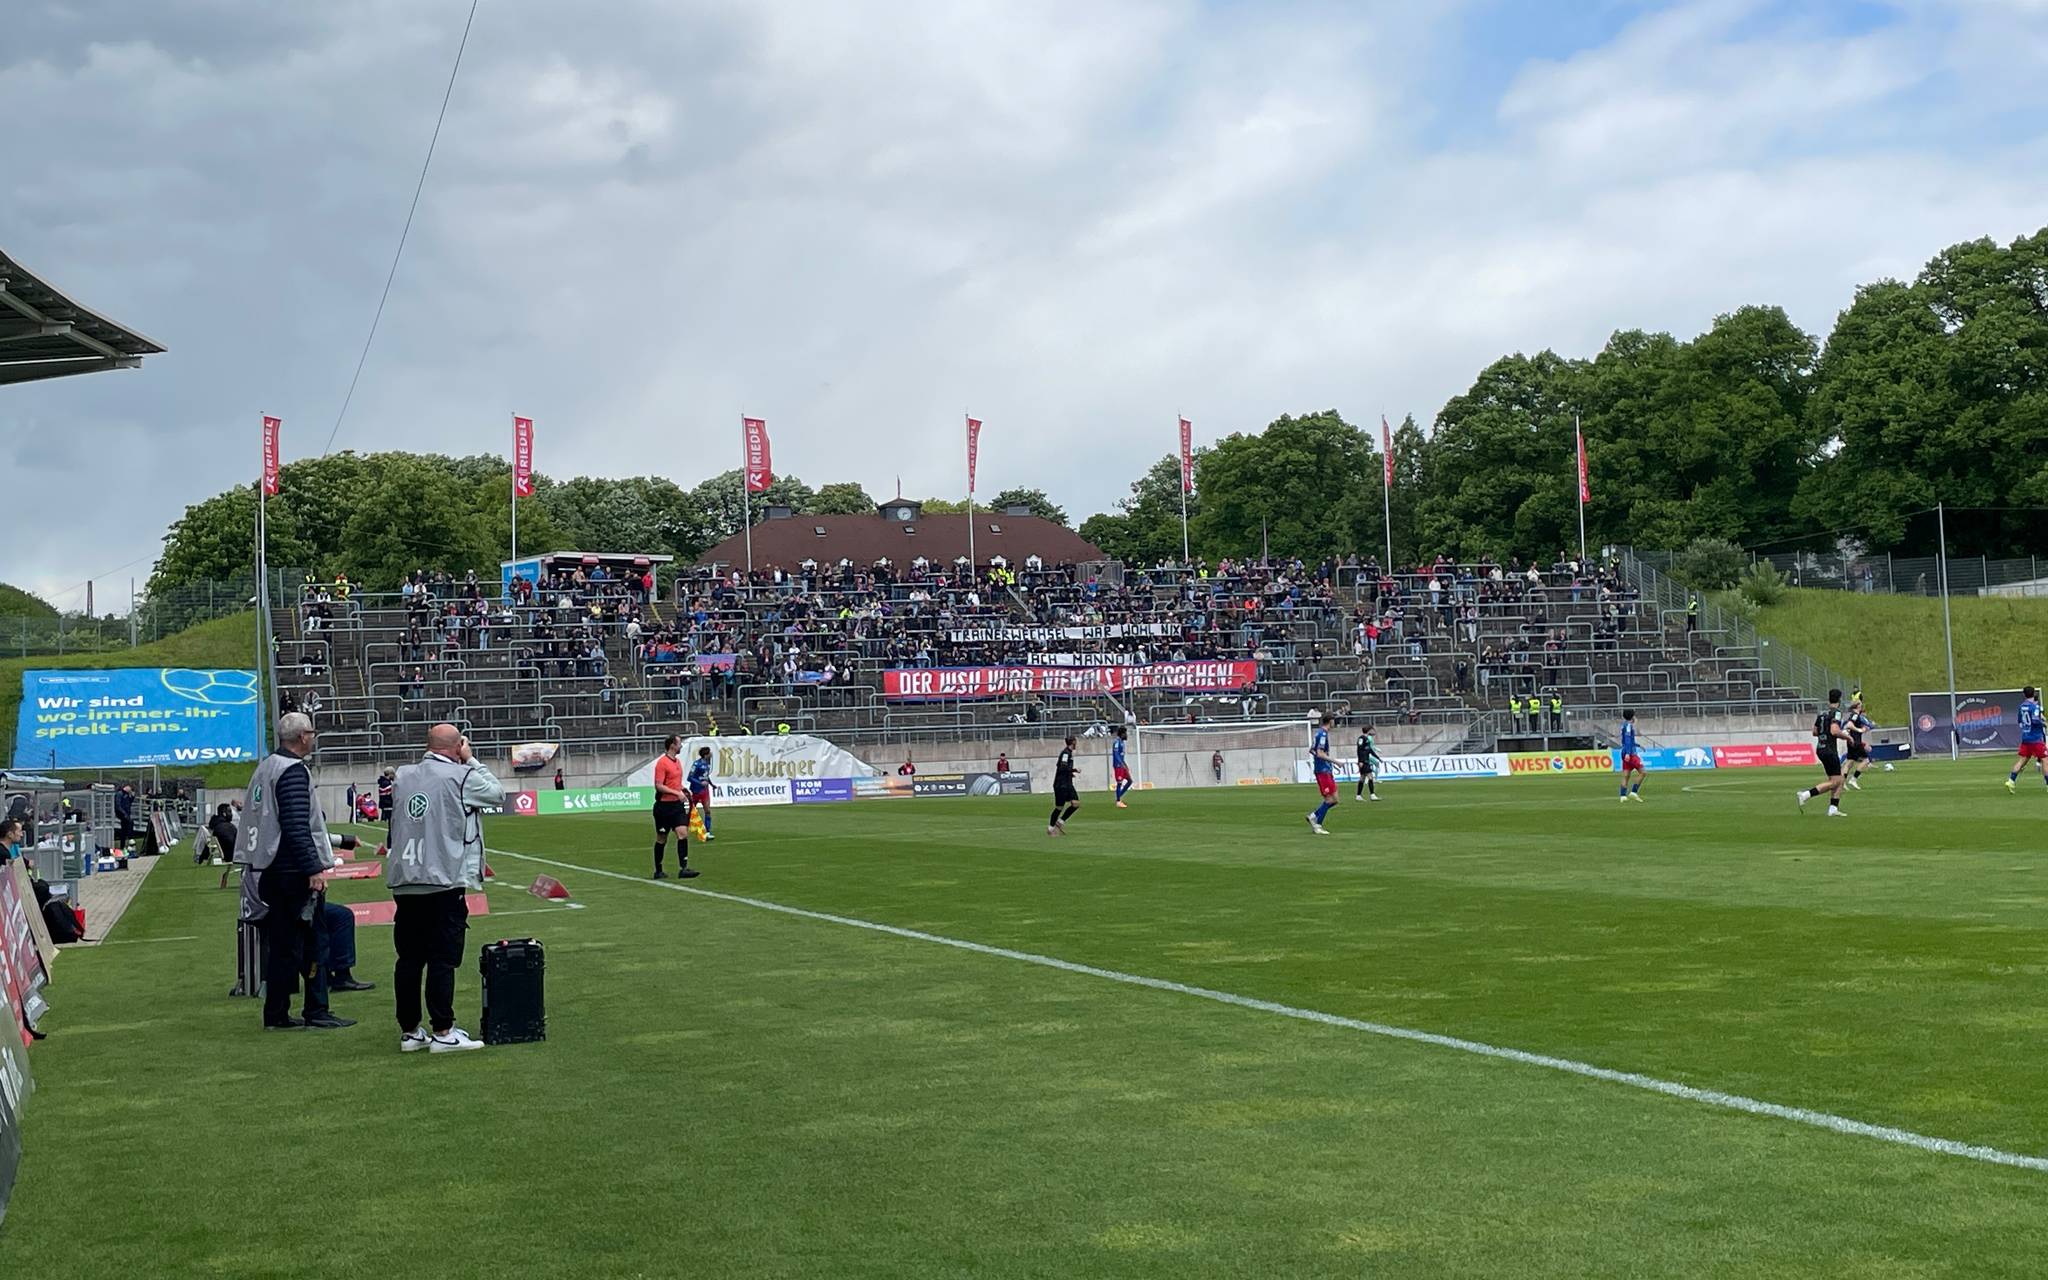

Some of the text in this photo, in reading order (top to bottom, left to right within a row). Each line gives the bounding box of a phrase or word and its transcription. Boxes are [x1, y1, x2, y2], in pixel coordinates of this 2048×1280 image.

[519, 421, 527, 468] RIEDEL
[747, 421, 762, 465] RIEDEL
[953, 624, 1180, 640] TRAINERWECHSEL WAR WOHL NIX
[1031, 654, 1058, 665] ACH
[900, 672, 933, 694] DER
[988, 669, 1034, 693] WIRD
[1043, 667, 1115, 692] NIEMALS
[1122, 662, 1234, 690] UNTERGEHEN!
[38, 695, 144, 709] Wir sind
[37, 707, 230, 724] wo-immer-ihr-
[35, 720, 188, 739] spielt-Fans.
[717, 746, 816, 780] Bitburger
[1430, 757, 1497, 772] ZEITUNG
[1509, 755, 1612, 771] WEST LOTTO
[590, 791, 640, 801] BERGISCHE
[727, 784, 787, 797] Reisecenter
